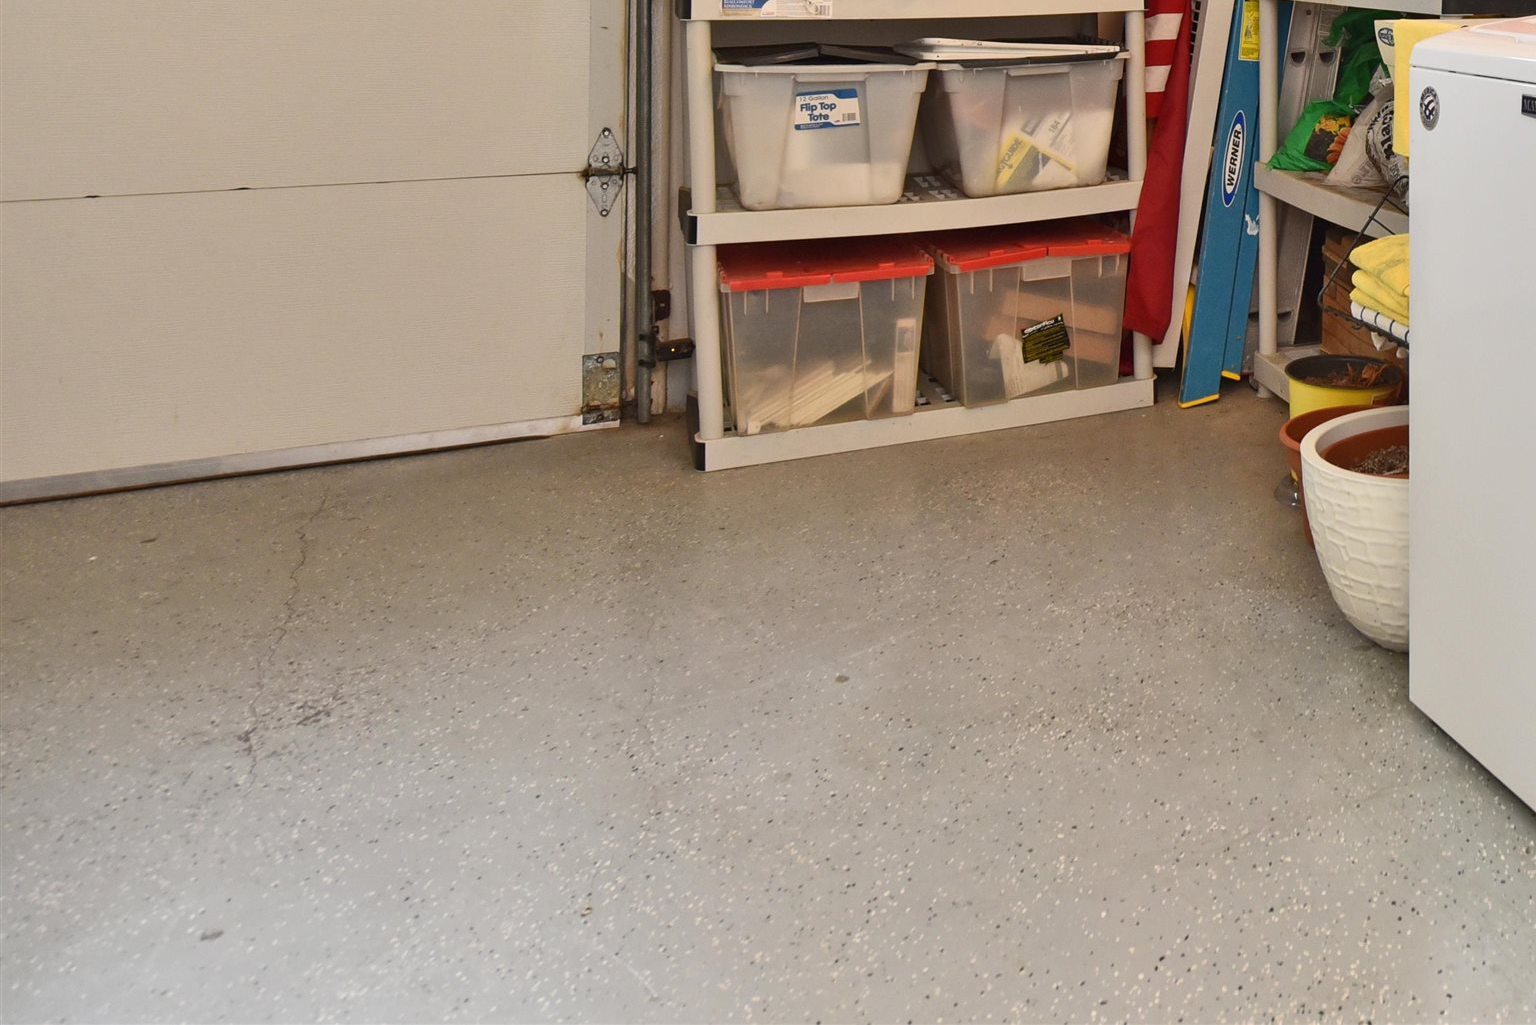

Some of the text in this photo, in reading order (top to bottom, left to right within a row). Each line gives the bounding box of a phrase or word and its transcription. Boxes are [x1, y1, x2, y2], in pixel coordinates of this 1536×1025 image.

[800, 102, 837, 112] Flip Top
[808, 113, 829, 122] Tote
[1226, 128, 1242, 188] WERNER
